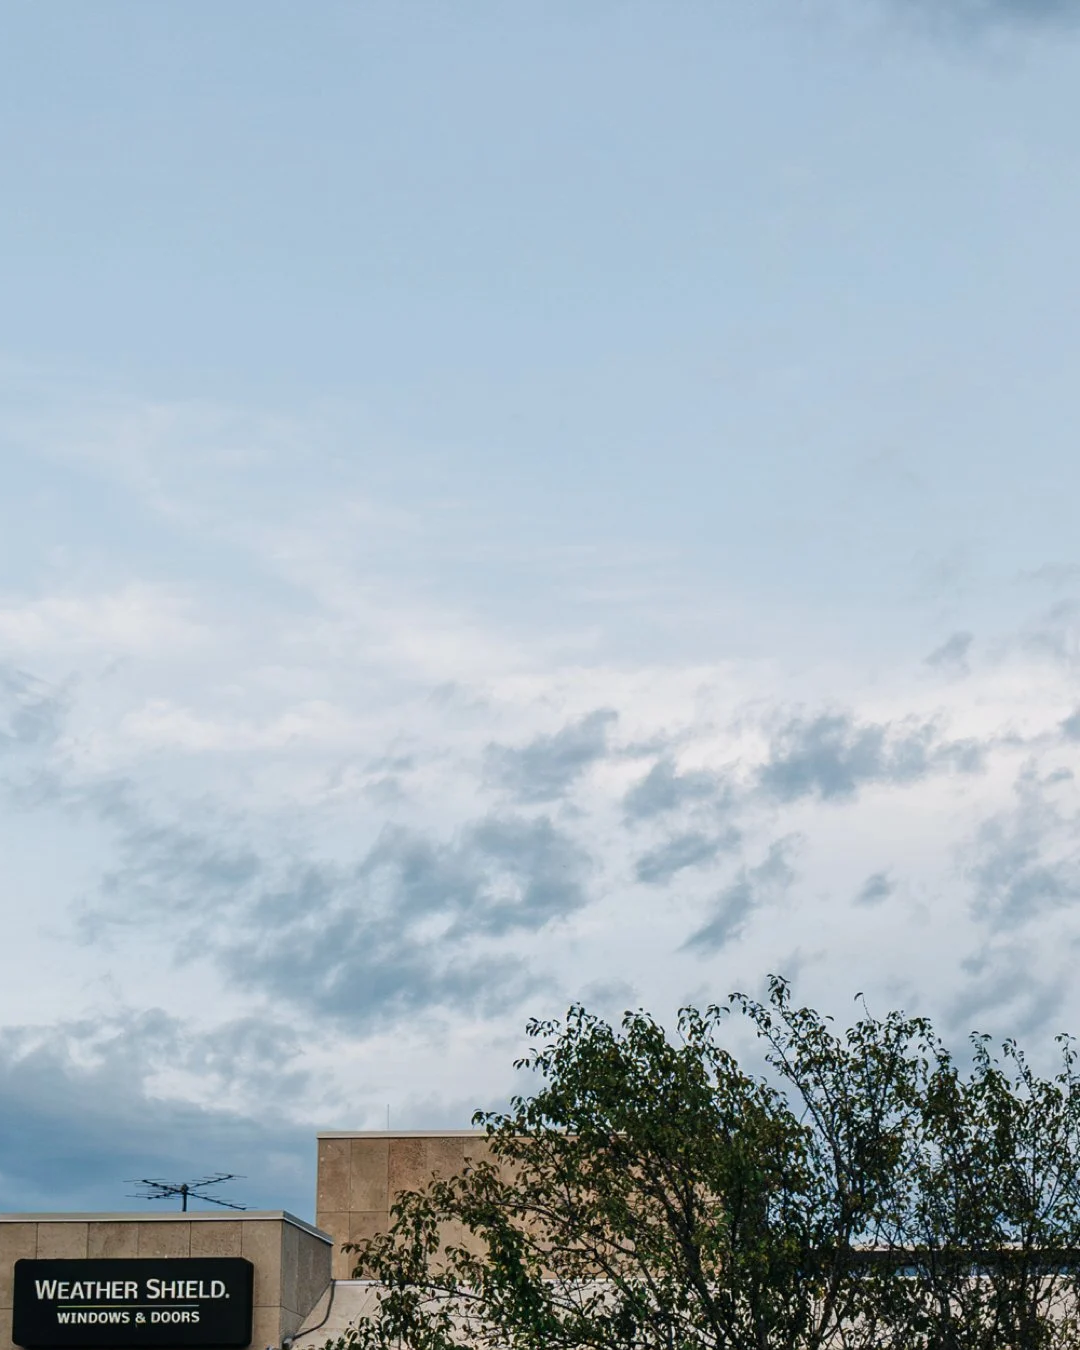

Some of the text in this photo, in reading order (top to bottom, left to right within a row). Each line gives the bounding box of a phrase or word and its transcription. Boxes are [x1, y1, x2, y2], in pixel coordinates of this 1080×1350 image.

[35, 1280, 138, 1299] WEATHER
[57, 1312, 200, 1324] WINDOWS & DOORS
